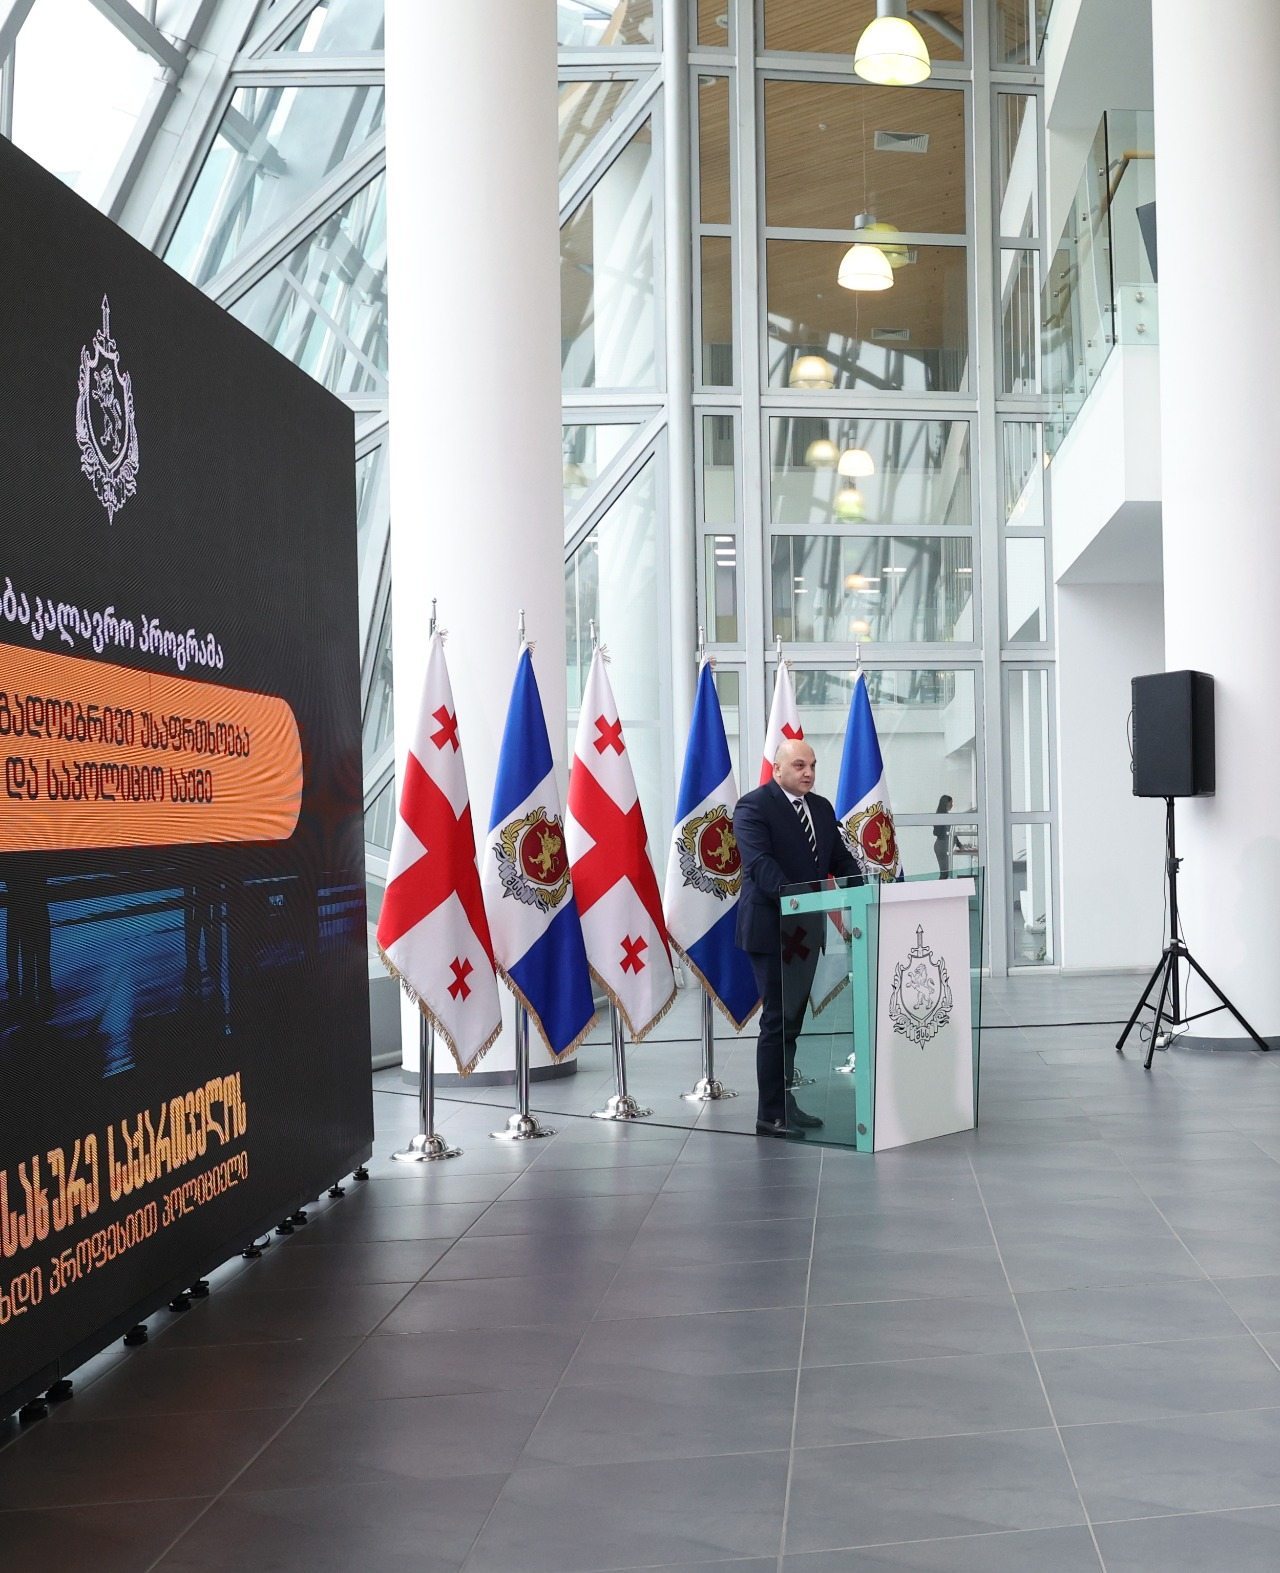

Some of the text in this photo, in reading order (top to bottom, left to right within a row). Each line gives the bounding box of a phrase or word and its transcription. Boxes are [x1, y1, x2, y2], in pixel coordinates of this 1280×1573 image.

[0, 576, 224, 671] ბაკალავრო პროგრამა
[6, 756, 213, 804] და საპოლიციო საქმე
[140, 713, 250, 757] უსაფრთხოება
[0, 1072, 246, 1257] სახურე საქართველოს
[50, 1202, 158, 1295] პროფესიით
[162, 1151, 248, 1227] პოლიციელი
